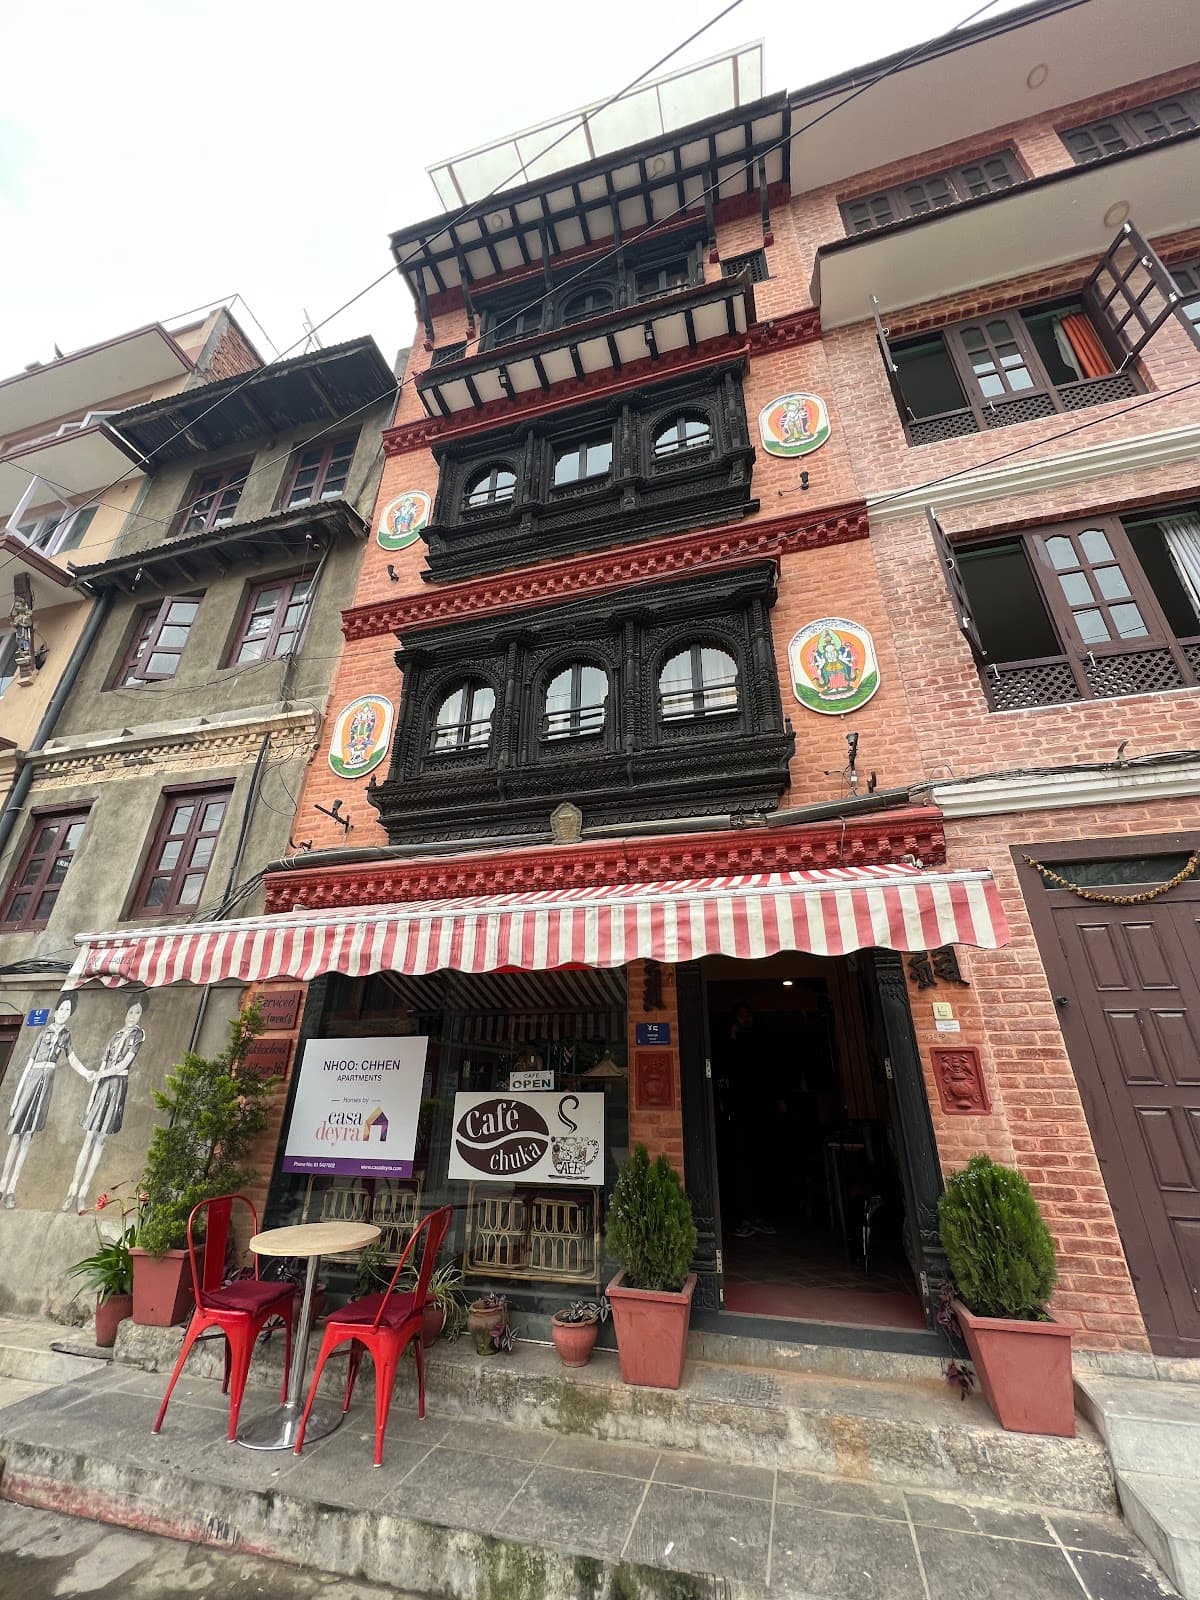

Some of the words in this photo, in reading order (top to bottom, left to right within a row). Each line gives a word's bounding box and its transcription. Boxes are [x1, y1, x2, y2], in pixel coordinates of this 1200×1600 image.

[323, 1061, 359, 1071] NHOO:
[361, 1060, 400, 1071] CHHEN
[336, 1074, 382, 1082] APARTMENTS
[512, 1079, 551, 1089] OPEN
[343, 1096, 361, 1104] Homes
[362, 1096, 369, 1104] by
[328, 1111, 363, 1125] casa
[465, 1101, 519, 1138] Café
[315, 1120, 360, 1146] deyra
[489, 1142, 541, 1171] chuka
